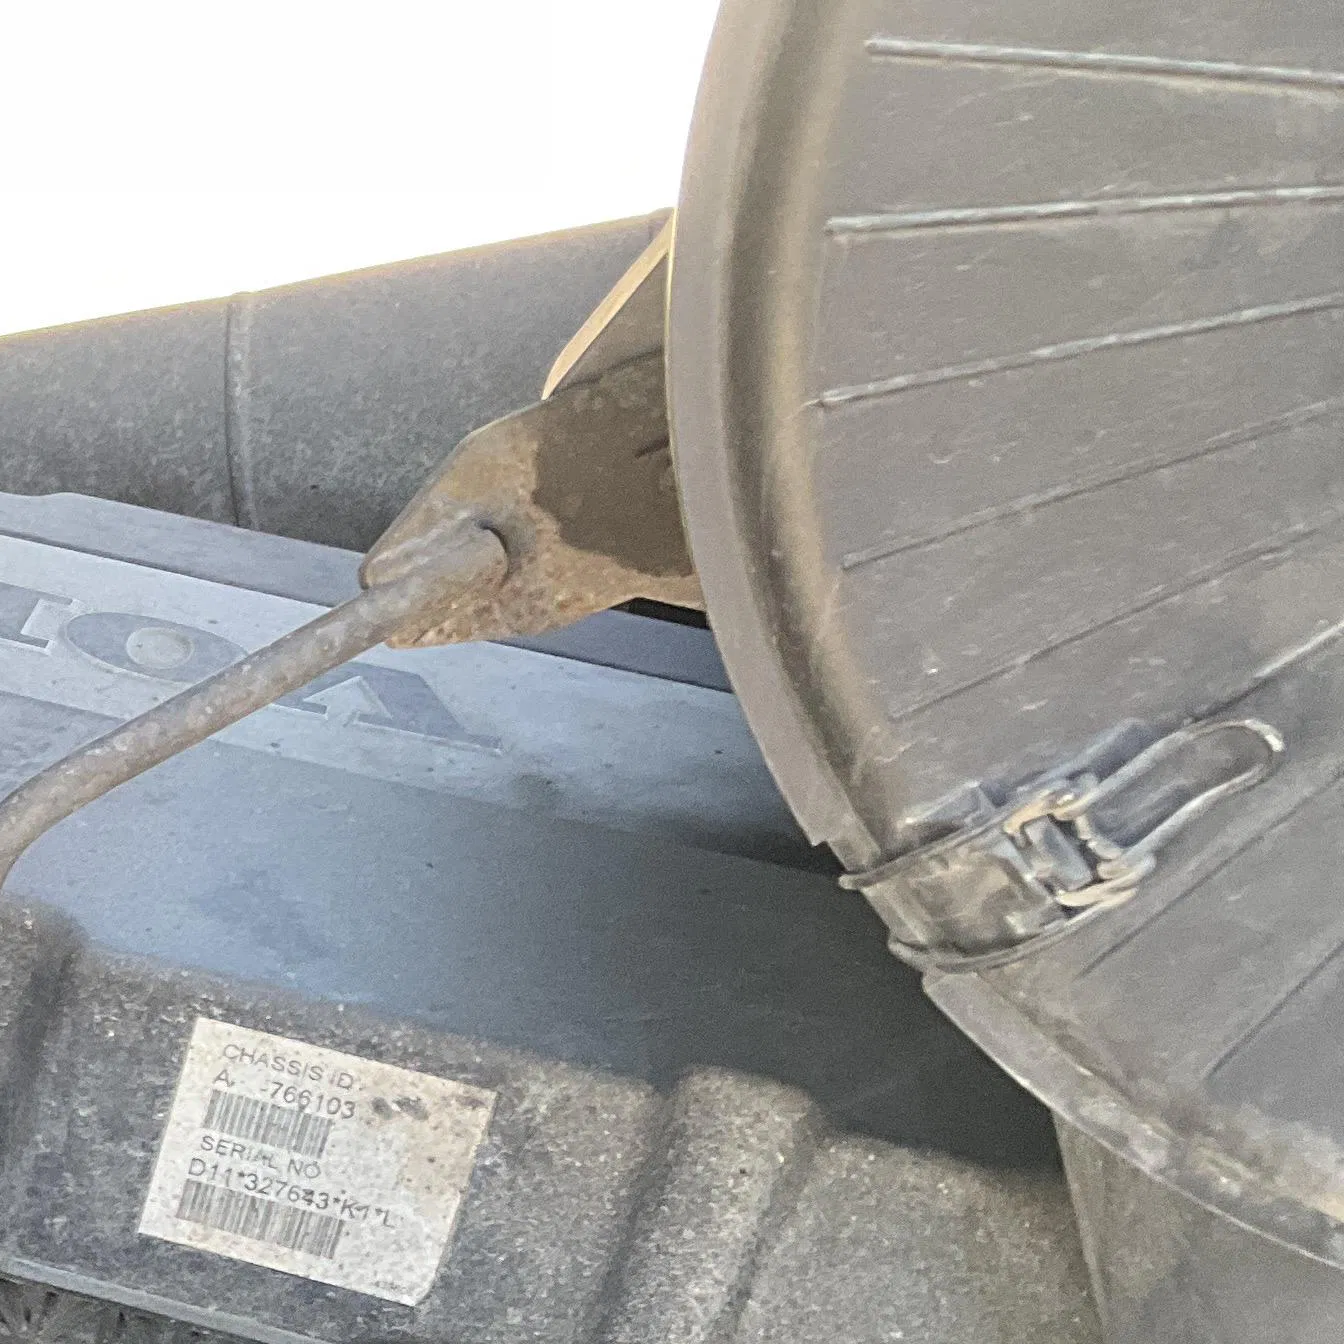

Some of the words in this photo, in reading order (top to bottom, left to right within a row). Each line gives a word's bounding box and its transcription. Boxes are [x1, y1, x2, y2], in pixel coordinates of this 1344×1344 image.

[223, 1043, 324, 1081] CHASSIS
[200, 1135, 279, 1170] SERIAL
[287, 1158, 322, 1180] NO
